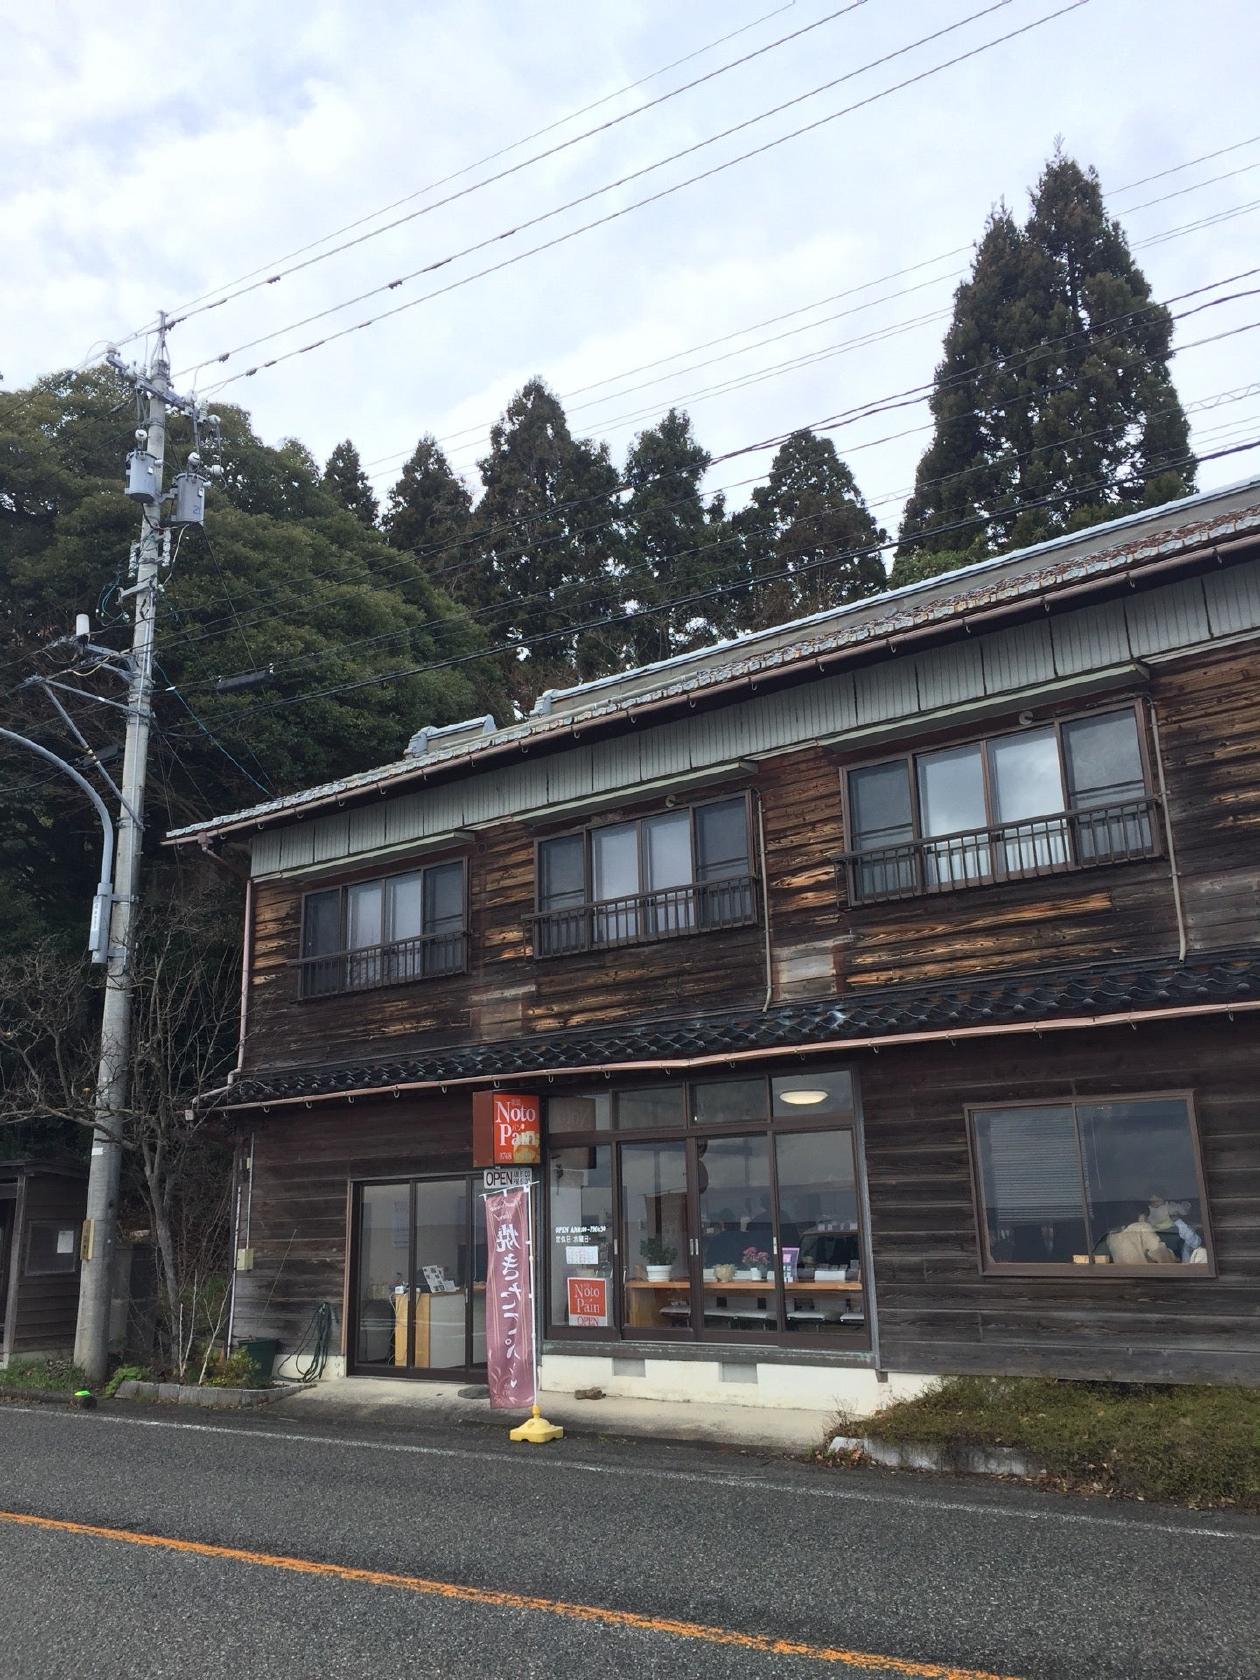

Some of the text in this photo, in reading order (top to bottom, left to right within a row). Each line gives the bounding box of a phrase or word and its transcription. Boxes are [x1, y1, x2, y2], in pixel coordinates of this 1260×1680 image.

[495, 1101, 536, 1123] Noto
[499, 1123, 537, 1146] Pain
[486, 1171, 513, 1186] OPEN
[574, 1284, 600, 1298] Noto
[576, 1298, 600, 1313] Pain
